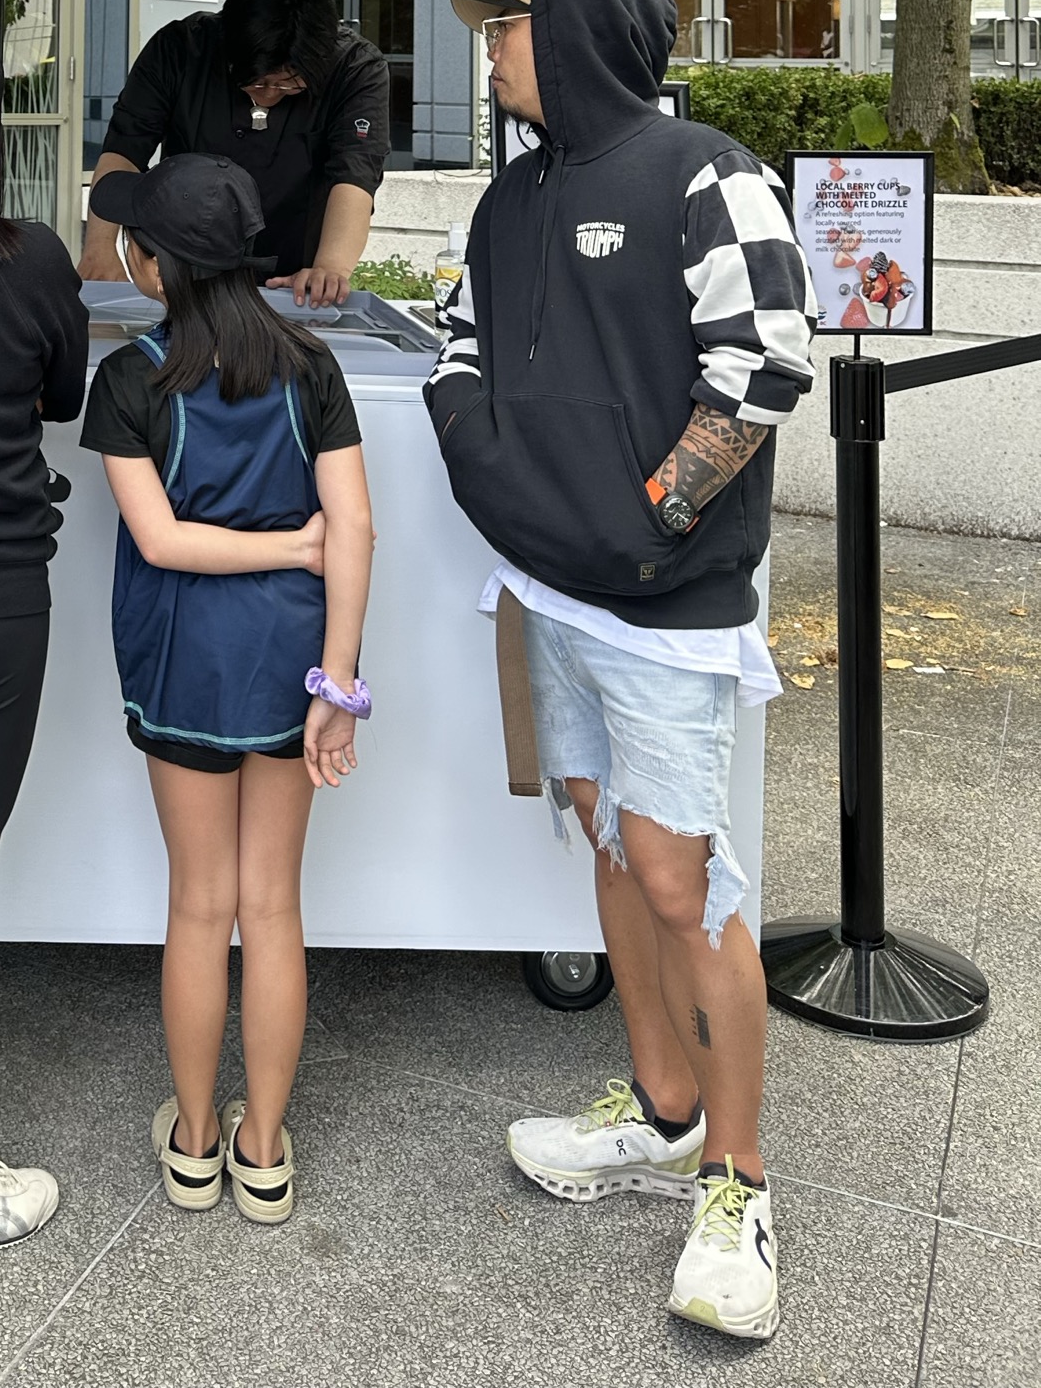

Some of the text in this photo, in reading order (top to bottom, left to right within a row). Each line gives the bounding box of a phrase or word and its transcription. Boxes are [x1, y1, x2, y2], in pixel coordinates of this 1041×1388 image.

[816, 200, 908, 208] CHOCOLATE DRIZZLE
[576, 221, 625, 232] MOTORCYCLES
[576, 230, 624, 258] TRIUMPH
